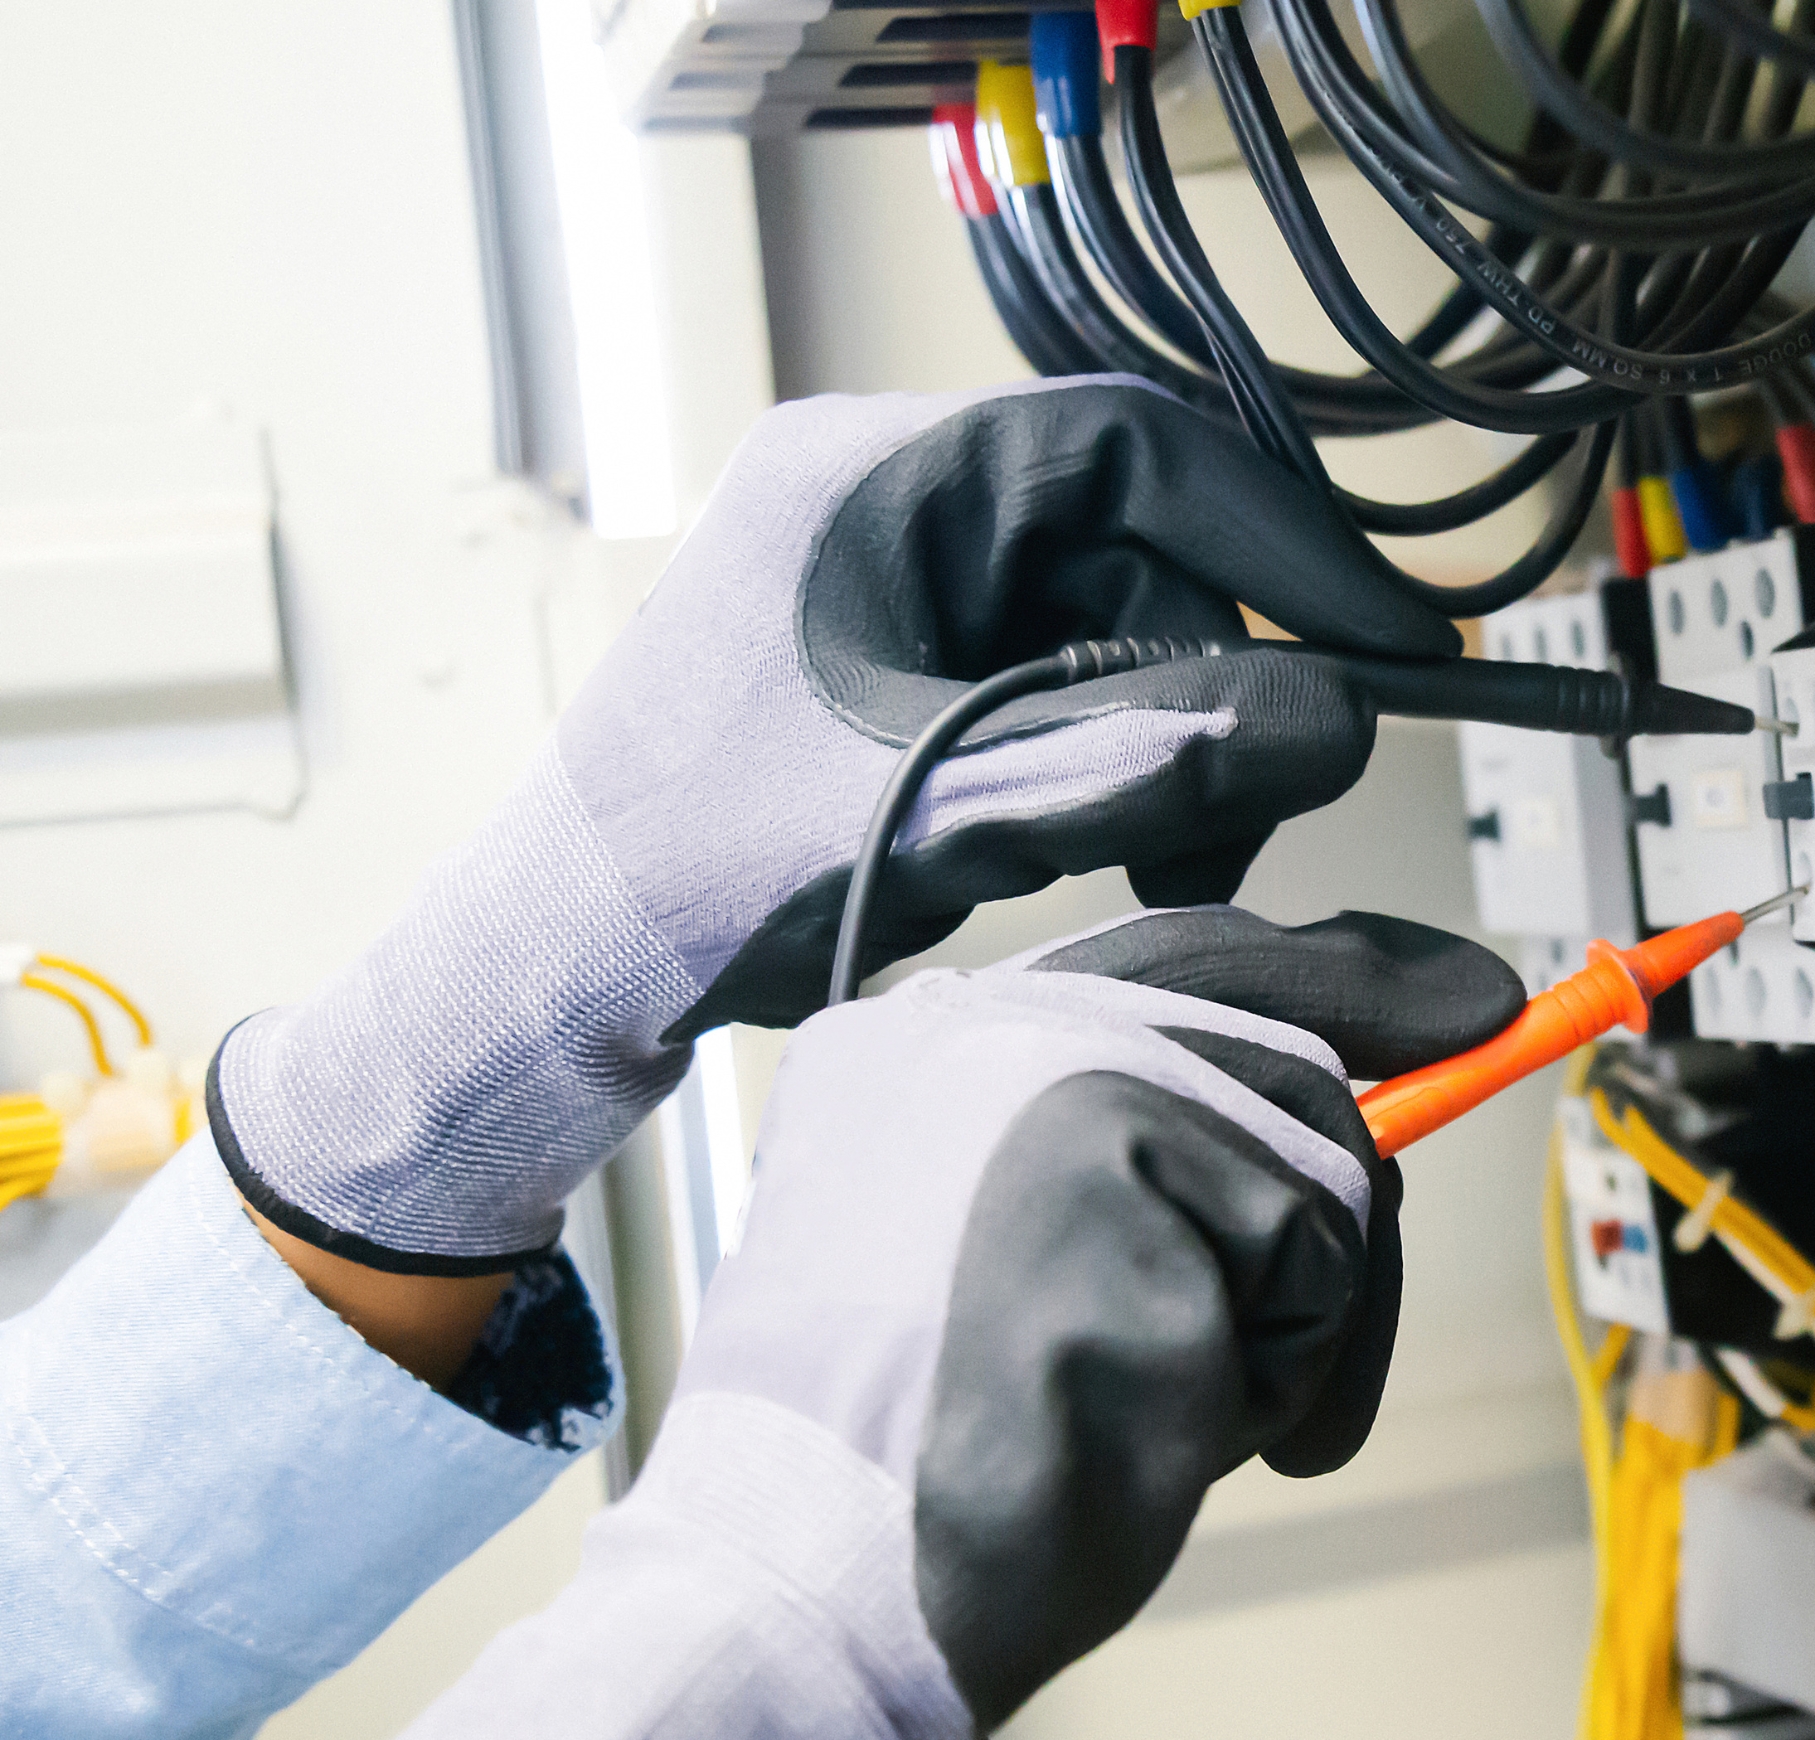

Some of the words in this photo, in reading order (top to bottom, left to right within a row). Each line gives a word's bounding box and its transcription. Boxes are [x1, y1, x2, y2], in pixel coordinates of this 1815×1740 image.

[1476, 259, 1522, 307] THW
[1659, 368, 1671, 386] 6
[1738, 333, 1811, 377] DODGE
